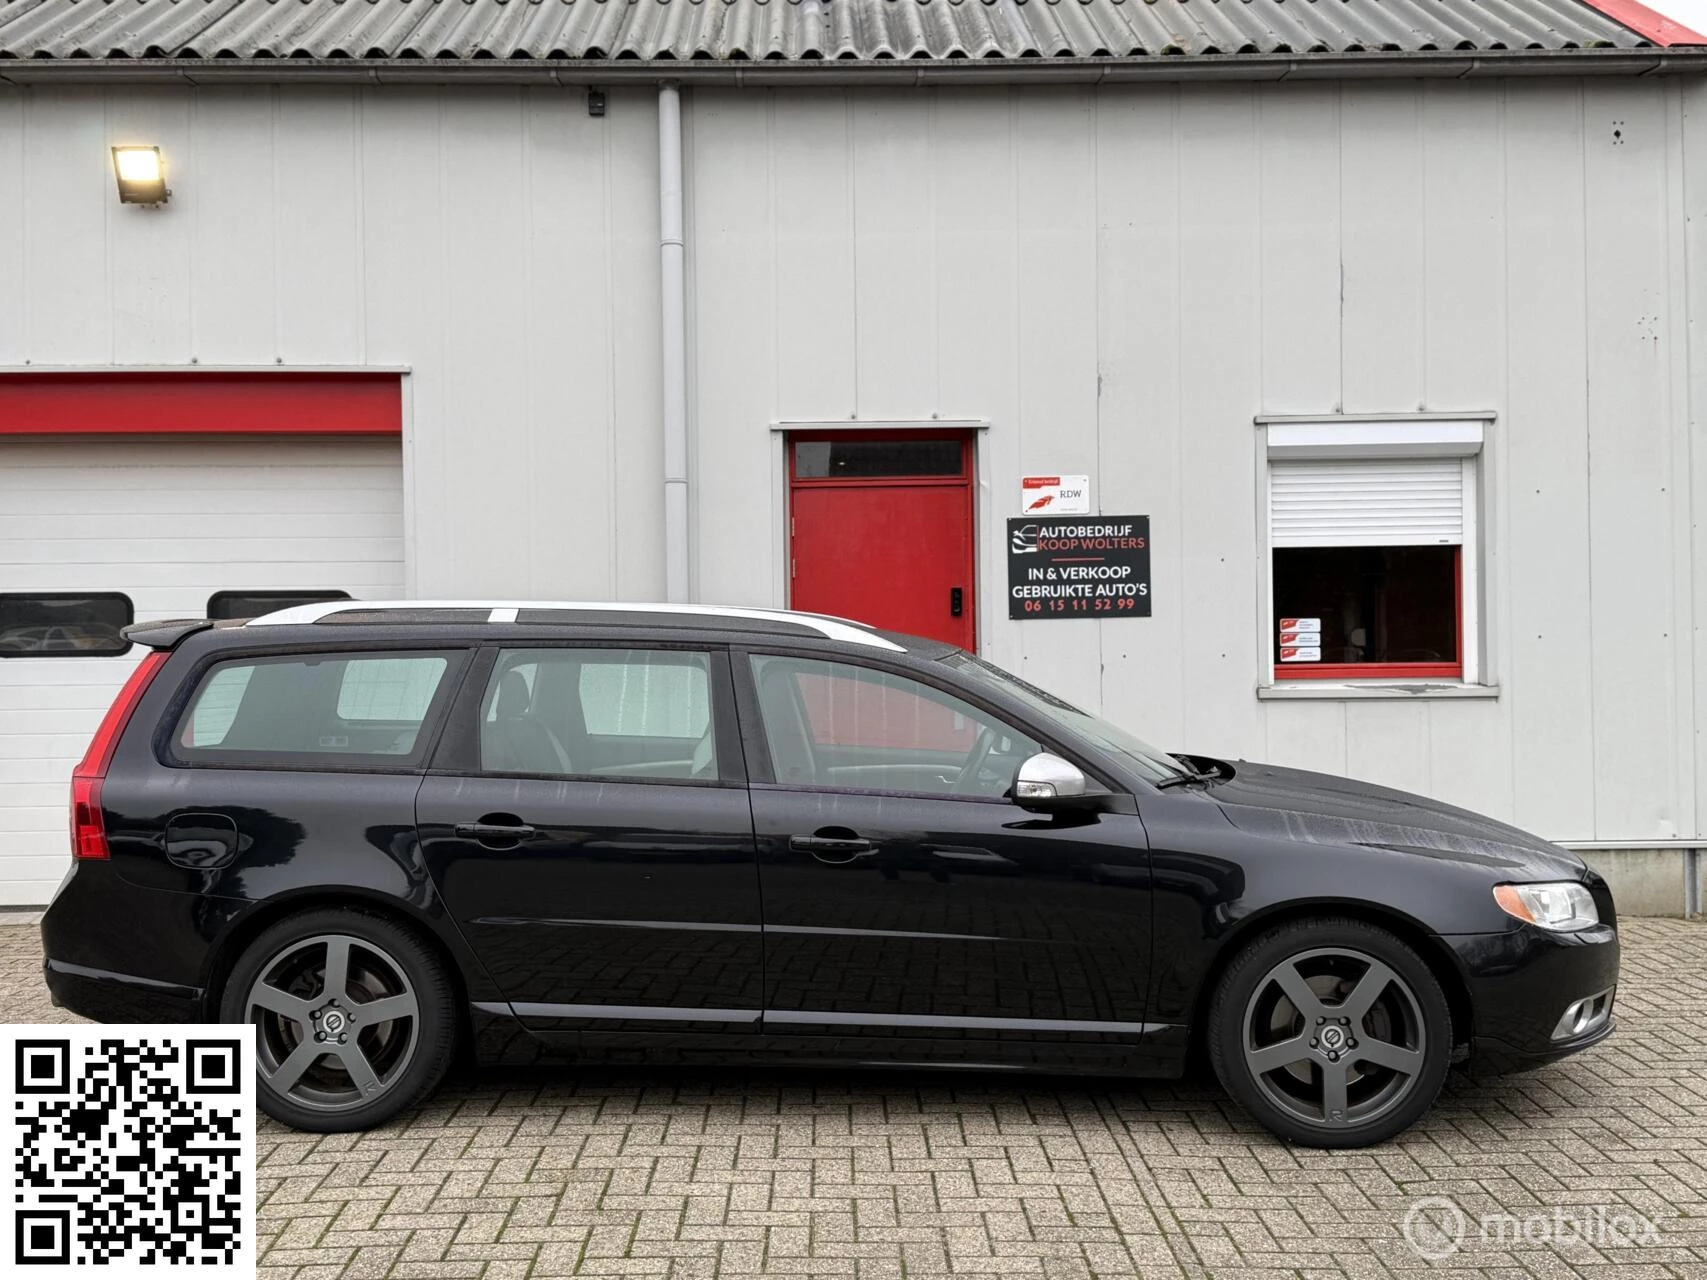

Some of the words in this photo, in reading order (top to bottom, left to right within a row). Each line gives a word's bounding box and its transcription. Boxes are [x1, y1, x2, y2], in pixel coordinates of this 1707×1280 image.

[1060, 490, 1082, 498] RDW
[1039, 525, 1132, 538] AUTOBEDRIJF
[1039, 539, 1079, 550] KOOP
[1080, 537, 1145, 549] WOLTERS
[1028, 568, 1044, 580] IN
[1046, 567, 1057, 580] &
[1059, 566, 1131, 579] VERKOOP
[1012, 584, 1093, 598] GEBRUIKTE
[1096, 583, 1148, 596] AUTO'S
[1024, 600, 1042, 611] 06
[1049, 600, 1065, 611] 15
[1072, 599, 1087, 610] 11
[1095, 598, 1111, 610] 52
[1117, 598, 1135, 609] 99
